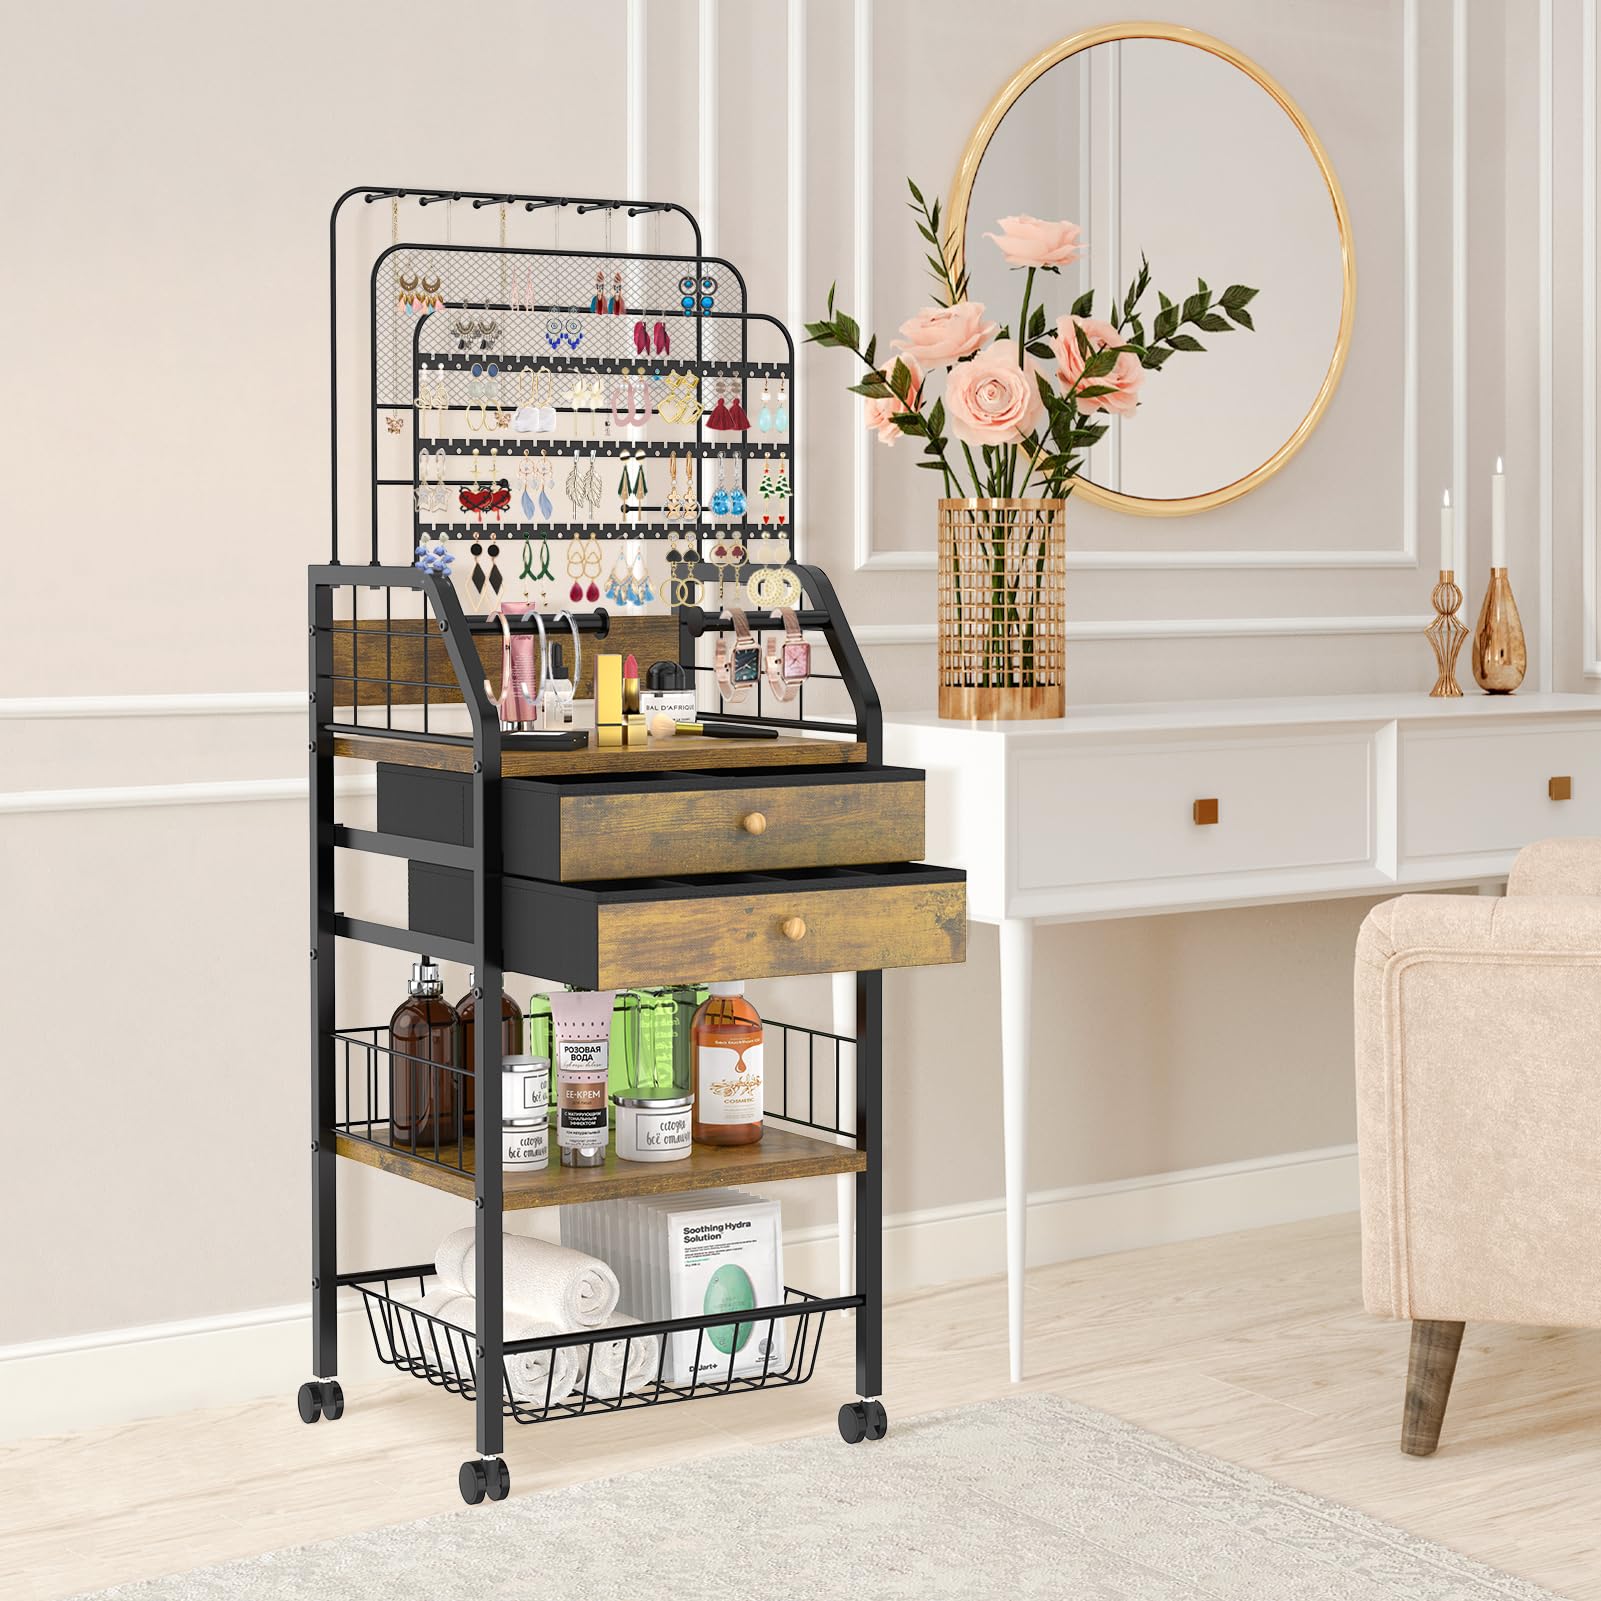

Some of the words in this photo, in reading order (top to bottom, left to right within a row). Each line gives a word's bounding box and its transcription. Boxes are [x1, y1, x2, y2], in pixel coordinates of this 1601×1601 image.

[564, 1045, 601, 1054] РОЗОВАЯ
[570, 1054, 594, 1062] ВОДА
[683, 1224, 724, 1235] Soothing
[724, 1221, 752, 1231] Hydra
[683, 1232, 722, 1244] Solution
